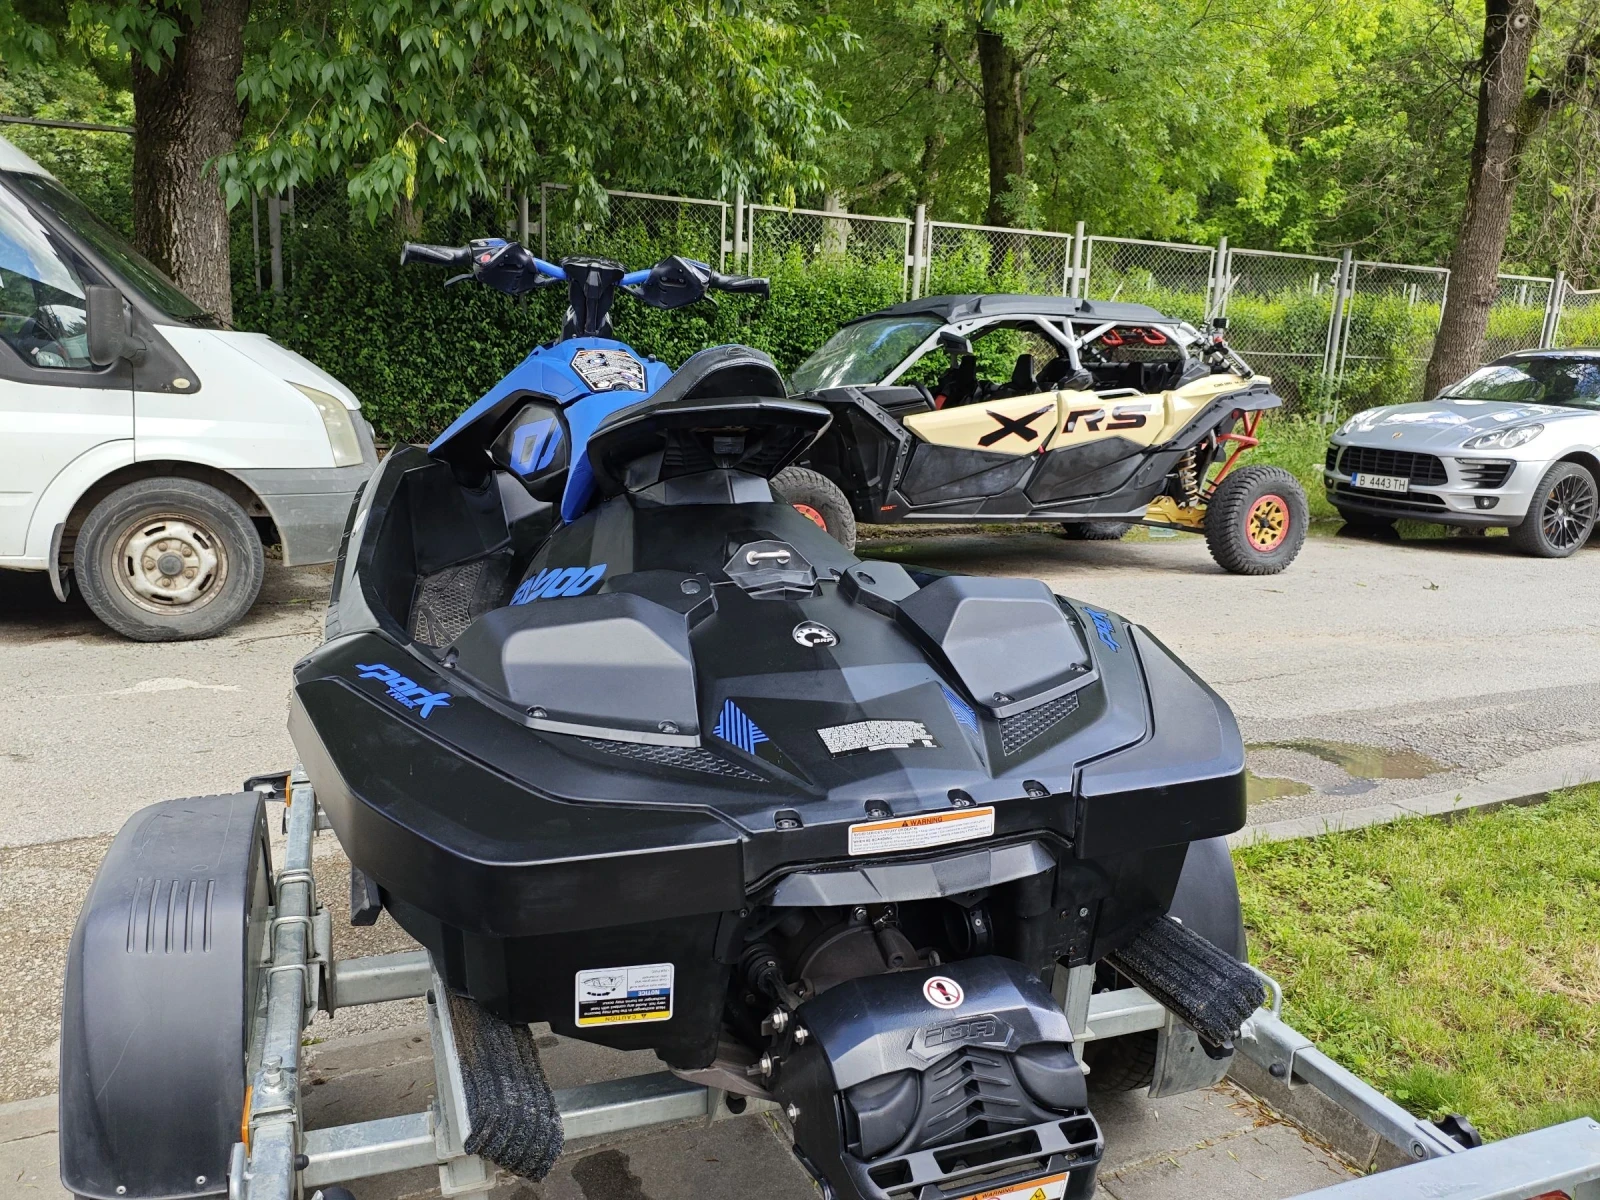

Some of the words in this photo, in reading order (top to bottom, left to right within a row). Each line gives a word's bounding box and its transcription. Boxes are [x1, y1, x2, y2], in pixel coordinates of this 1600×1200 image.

[1061, 404, 1152, 434] RS
[1359, 475, 1366, 486] B
[1369, 476, 1392, 489] 4443
[1393, 478, 1406, 491] TH
[910, 816, 943, 827] WARNING
[981, 1186, 1015, 1199] WARNING
